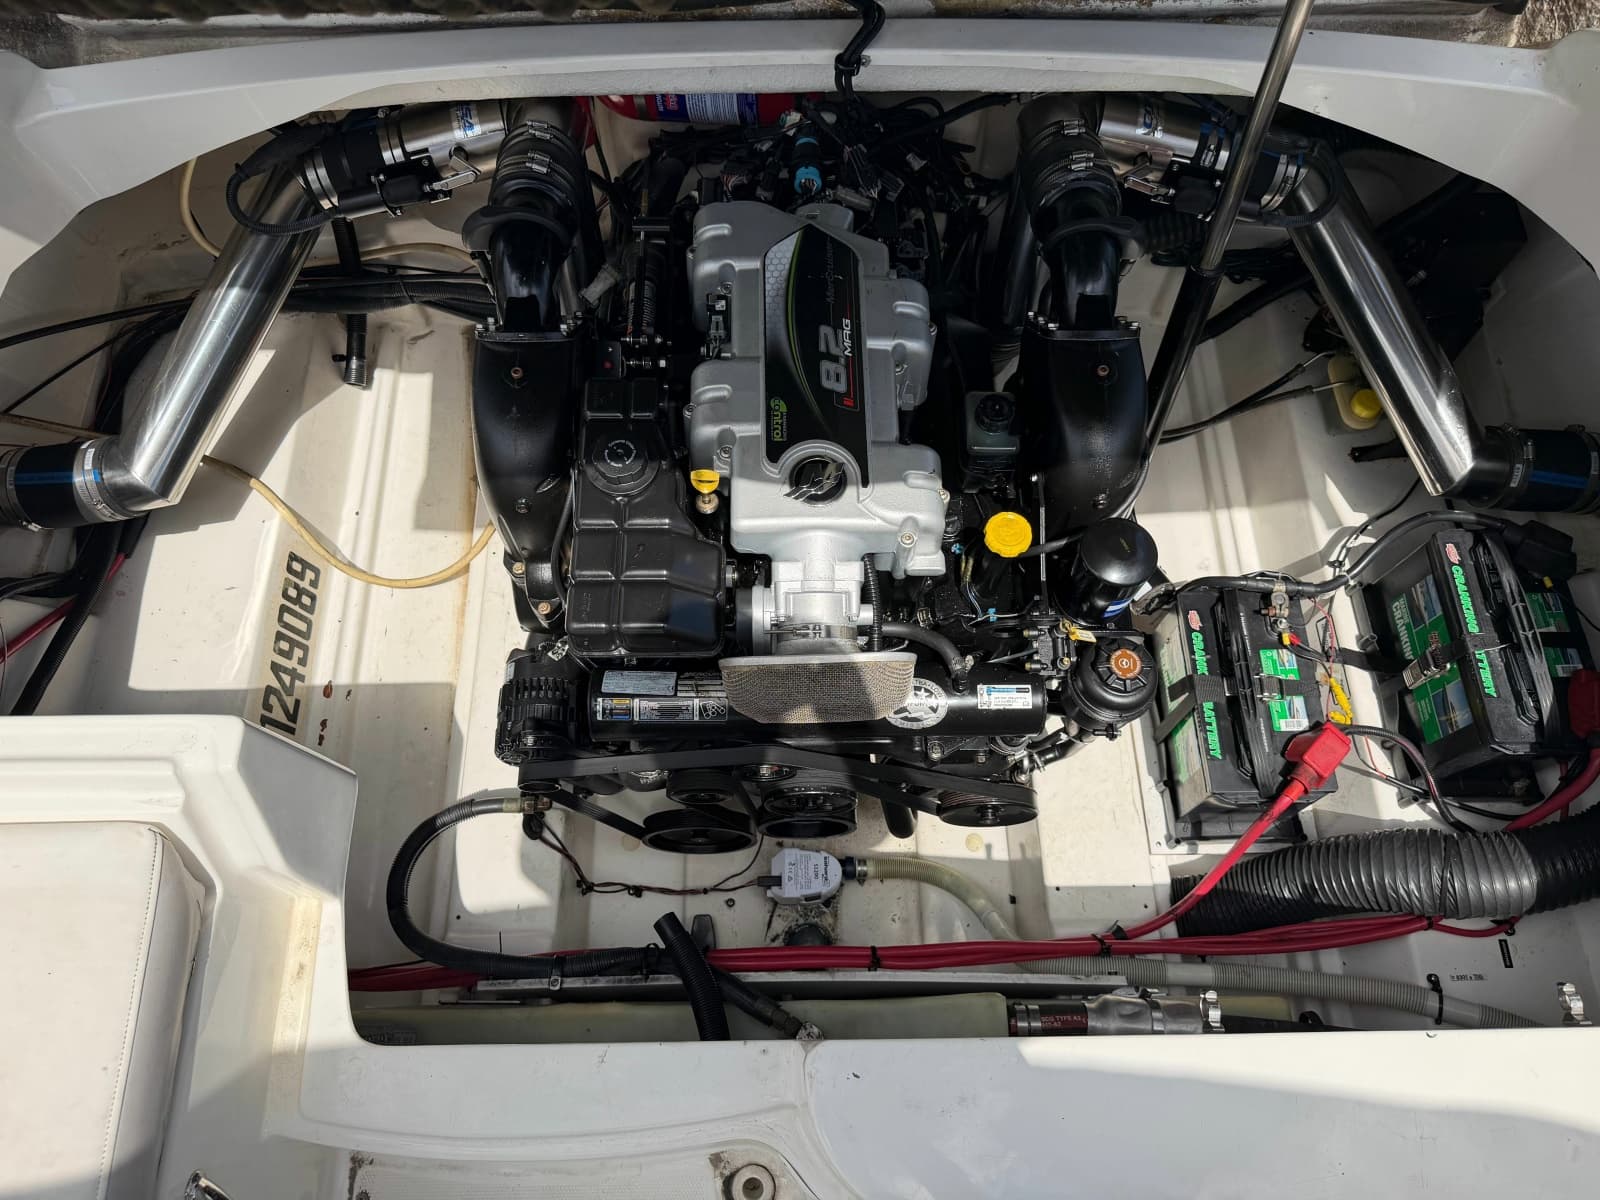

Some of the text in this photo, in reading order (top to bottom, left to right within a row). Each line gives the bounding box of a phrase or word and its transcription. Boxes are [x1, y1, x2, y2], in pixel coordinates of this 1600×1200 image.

[818, 324, 848, 393] 8.2
[842, 317, 853, 357] MAG
[1451, 565, 1480, 634] CRANKING
[259, 551, 321, 736] 1249089
[1191, 631, 1209, 676] CRANK
